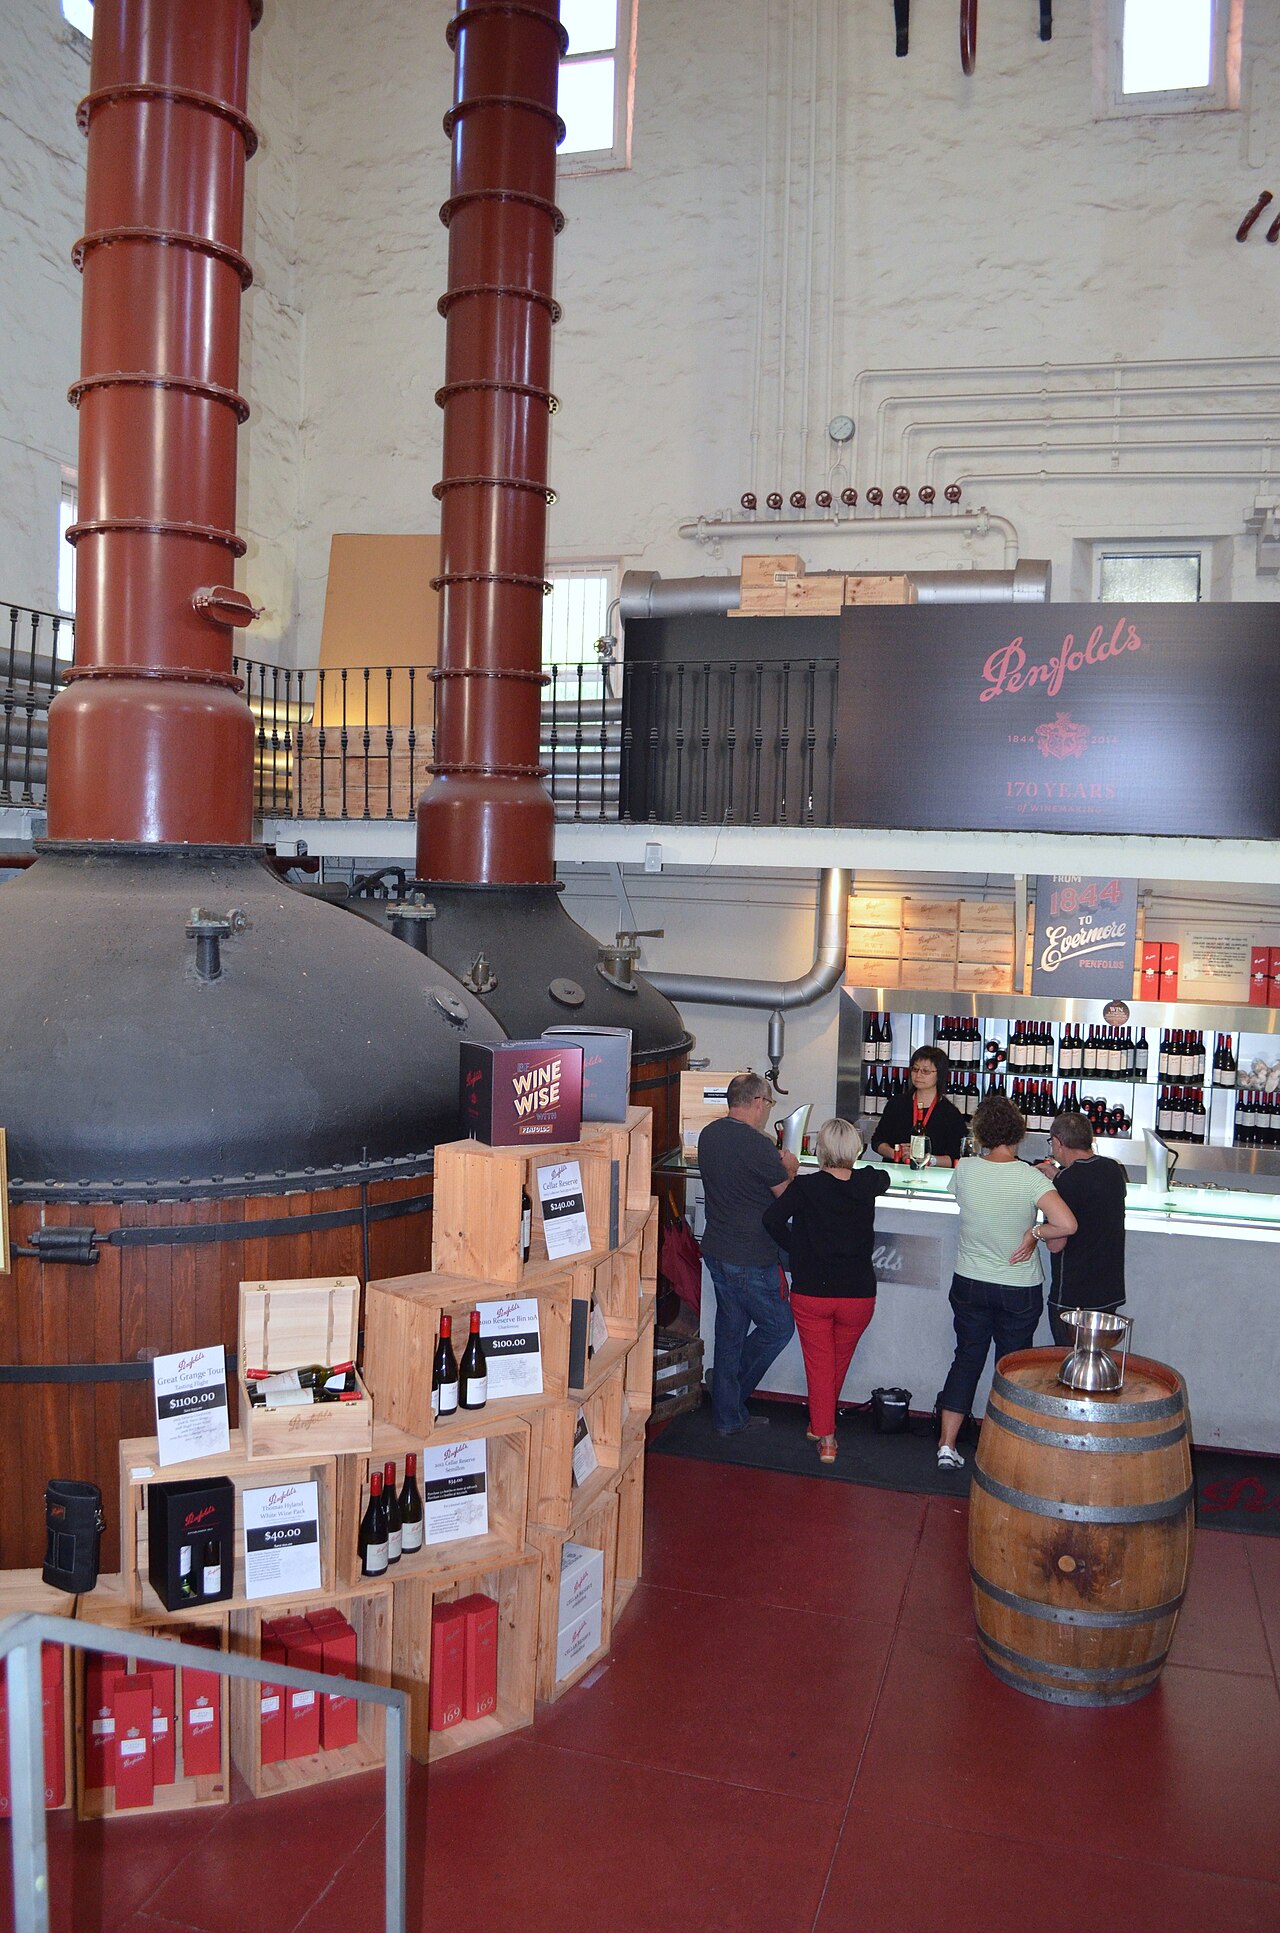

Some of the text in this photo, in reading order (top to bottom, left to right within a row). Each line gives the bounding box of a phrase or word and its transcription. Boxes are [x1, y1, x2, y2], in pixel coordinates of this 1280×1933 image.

[979, 617, 1141, 702] Penfolds
[1007, 735, 1034, 743] 1844
[1007, 781, 1116, 800] 170 YEARS
[1052, 875, 1081, 883] FROM
[1050, 879, 1121, 915] 1844
[1078, 915, 1092, 926] TO
[1041, 921, 1126, 972] Evermore
[1078, 959, 1124, 969] PENFOLDS
[512, 1059, 562, 1095] WINE
[514, 1081, 560, 1117] WISE
[536, 1112, 558, 1121] WITH
[542, 1178, 578, 1190] Cellar Reserve
[550, 1199, 575, 1211] $240.00
[492, 1317, 515, 1325] Reserve
[516, 1315, 526, 1323] Bin
[492, 1338, 526, 1349] $100.00
[178, 1352, 205, 1373] Penfolds
[157, 1366, 224, 1386] Great Grange Tour
[175, 1379, 209, 1391] Tasting Flight
[169, 1391, 215, 1410] $1100.00
[445, 1458, 459, 1466] Cellar
[459, 1457, 476, 1465] Reserve
[268, 1486, 296, 1506] Penfolds
[262, 1501, 303, 1512] Thomas Hyland
[260, 1511, 277, 1519] White
[293, 1508, 305, 1516] Pack
[264, 1527, 301, 1542] $40.00
[476, 1696, 493, 1714] 169
[443, 1706, 461, 1725] 169
